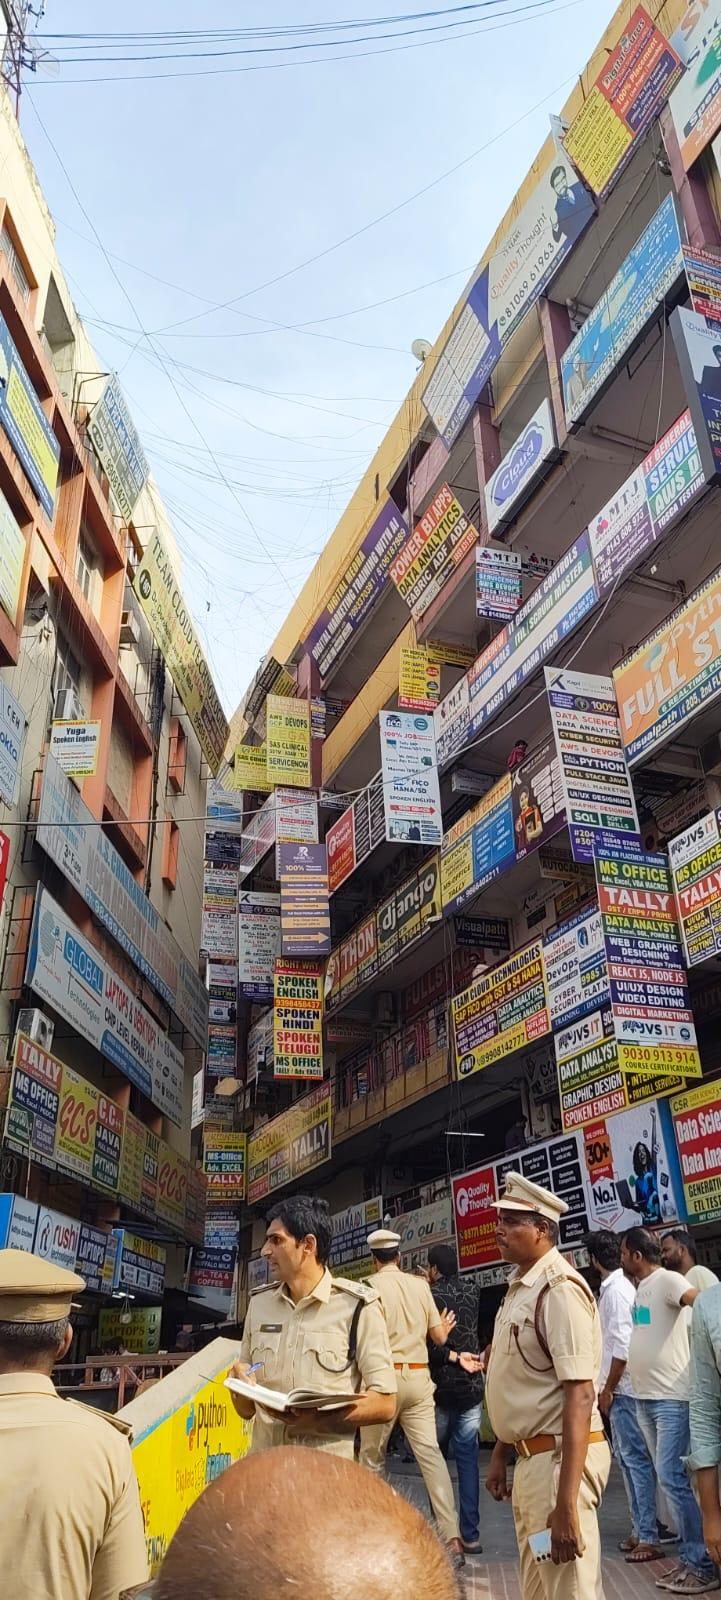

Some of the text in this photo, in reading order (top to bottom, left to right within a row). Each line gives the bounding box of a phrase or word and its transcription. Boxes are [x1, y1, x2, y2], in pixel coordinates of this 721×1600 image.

[516, 213, 547, 258] Thought
[644, 413, 692, 471] IT GENERAL
[501, 440, 535, 490] Cloud
[105, 457, 132, 523] 9908142777
[609, 478, 640, 520] MTJ
[655, 469, 686, 516] AWS
[657, 472, 705, 529] TOSCA TESTING
[390, 487, 453, 582] POWER BI APPS
[399, 506, 461, 595] DATA ANALYTICS
[494, 552, 518, 563] MTJ
[407, 517, 468, 608] FABRIC ADF ADB
[154, 535, 195, 644] TEAM CLOUD
[312, 518, 399, 657] DIGITAL MARKETING TRAINING WITH AI
[553, 562, 584, 601] MASTER
[508, 547, 579, 637] IT GENERAL CONTROLS
[472, 631, 559, 730] SAP FICO
[622, 658, 687, 730] FULL
[668, 670, 708, 710] REALTIME
[590, 700, 617, 713] 100%
[6, 704, 21, 730] CEH
[285, 717, 308, 729] DEVOPS
[555, 711, 618, 728] DATA SCIENCE
[627, 682, 712, 757] Visualpath 2nd
[66, 726, 86, 736] Yuga
[556, 720, 620, 736] DATA ANALYTICS
[52, 735, 97, 744] Spoken English
[194, 710, 219, 773] 9908142777
[269, 741, 308, 752] SAS CLINICAL
[559, 731, 621, 747] CYBER SECURITY
[560, 743, 624, 759] AWS DEVOPS
[269, 758, 309, 768] SERVICENOW
[579, 756, 625, 773] PYTHON
[565, 769, 627, 785] FULL STACK JAVA
[565, 779, 631, 796] DIGITAL MARKETING
[569, 790, 631, 806] UI/UX DESIGNING
[574, 812, 623, 824] SQL SOFT
[607, 821, 630, 831] SKILLS
[705, 819, 714, 834] IT
[285, 864, 304, 872] 100%
[600, 859, 667, 883] MS OFFICE
[677, 865, 689, 884] MS
[604, 886, 670, 912] TALLY
[681, 871, 721, 909] TALLY
[382, 872, 435, 931] django
[607, 905, 672, 920] GST PRIME
[605, 915, 675, 934] DATA ANALYST
[686, 919, 710, 936] DESIGN
[552, 938, 566, 950] DATA
[609, 936, 679, 954] WEB GRAPHIC
[621, 947, 670, 961] DESIGNING
[65, 936, 103, 996] GLOBAL
[276, 960, 299, 969] RIGHT
[546, 956, 600, 985] DevOps 9985
[278, 976, 318, 987] SPOKEN
[453, 944, 541, 1010] TEAM CLOUD TECHNOLOGIES
[611, 966, 684, 983] REACT JS, NODE JS
[68, 969, 100, 1026] Technologies
[277, 987, 319, 999] ENGLISH
[455, 963, 542, 1022] SAP FICO with GST HANA
[554, 985, 577, 1004] CYBER
[616, 981, 684, 998] UI/UX DESIGN
[499, 984, 544, 1017] DATA ANALYTICS
[617, 993, 685, 1008] VIDEO EDITING
[276, 1008, 320, 1019] SPOKEN
[617, 1006, 690, 1021] DIGITAL MARKETING
[133, 1012, 157, 1051] DESKTOPS
[282, 1019, 314, 1030] HINDI
[591, 1019, 600, 1035] IT
[664, 1024, 675, 1037] IT
[276, 1032, 320, 1043] SPOKEN
[277, 1042, 320, 1055] TELUGU
[623, 1047, 696, 1065] 9030 913 914
[21, 1039, 61, 1083] TALLY
[276, 1057, 321, 1067] MS OFFICE
[560, 1042, 618, 1081] DATA ANALYST
[625, 1061, 697, 1074] COURSE CERTIFICATIONS
[15, 1072, 58, 1111] MS OFFICE
[563, 1073, 623, 1110] GRAPHIC DESIGN
[565, 1091, 625, 1127] SPOKEN ENGLISH
[673, 1098, 689, 1112] CSR
[59, 1094, 97, 1145] GCS
[96, 1125, 120, 1149] JAVA
[593, 1128, 605, 1137] OFFER
[675, 1118, 697, 1143] Data
[293, 1122, 328, 1162] TALLY
[587, 1141, 611, 1166] 30+
[94, 1153, 118, 1176] PYTHON
[143, 1152, 158, 1177] GST
[207, 1163, 242, 1172] Adv. EXCEL
[681, 1150, 702, 1176] Data
[206, 1174, 242, 1183] TALLY
[468, 1182, 490, 1198] Quality
[592, 1182, 617, 1206] No.1
[469, 1193, 494, 1209] Thought
[693, 1198, 704, 1212] ETL
[53, 1223, 79, 1251] rushi
[207, 1254, 221, 1262] PURE
[217, 1261, 231, 1269] MILK
[197, 1278, 224, 1287] COFFEE
[197, 1392, 227, 1449] python
